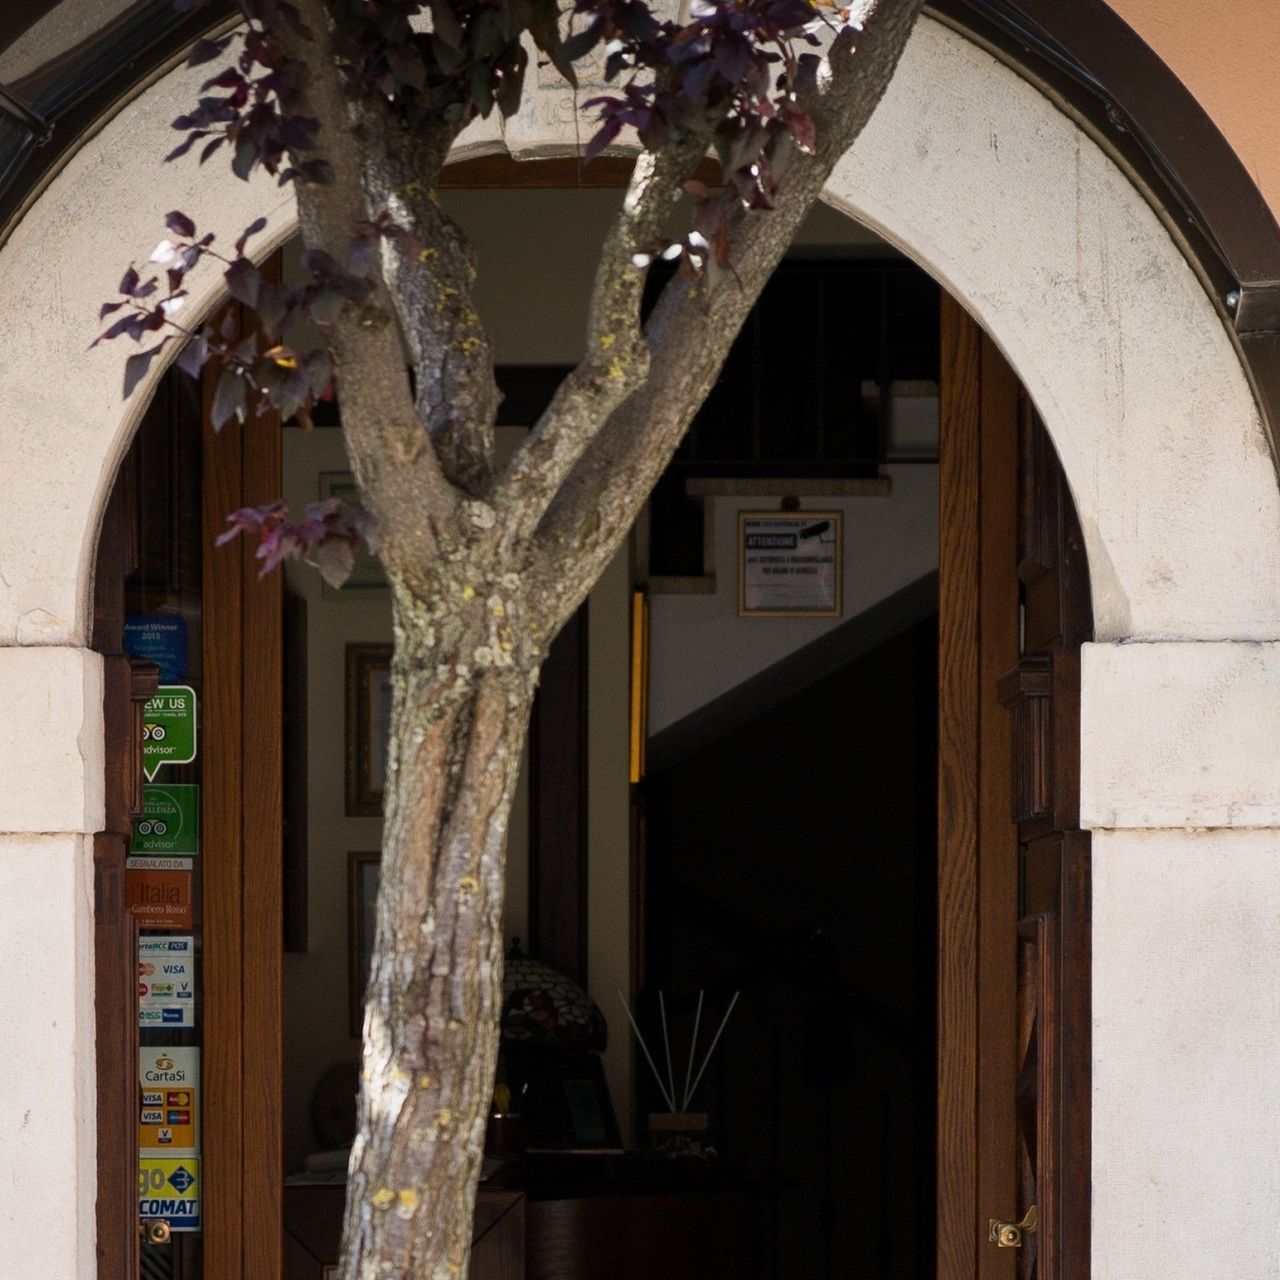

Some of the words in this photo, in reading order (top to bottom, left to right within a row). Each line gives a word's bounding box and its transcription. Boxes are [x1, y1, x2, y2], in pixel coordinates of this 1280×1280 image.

[150, 623, 178, 631] Winner
[169, 698, 185, 709] US
[130, 859, 172, 868] SEGNALATO
[163, 965, 185, 974] VISA
[145, 1070, 185, 1081] CartaSi
[143, 1094, 162, 1102] VISA
[143, 1112, 162, 1120] VISA
